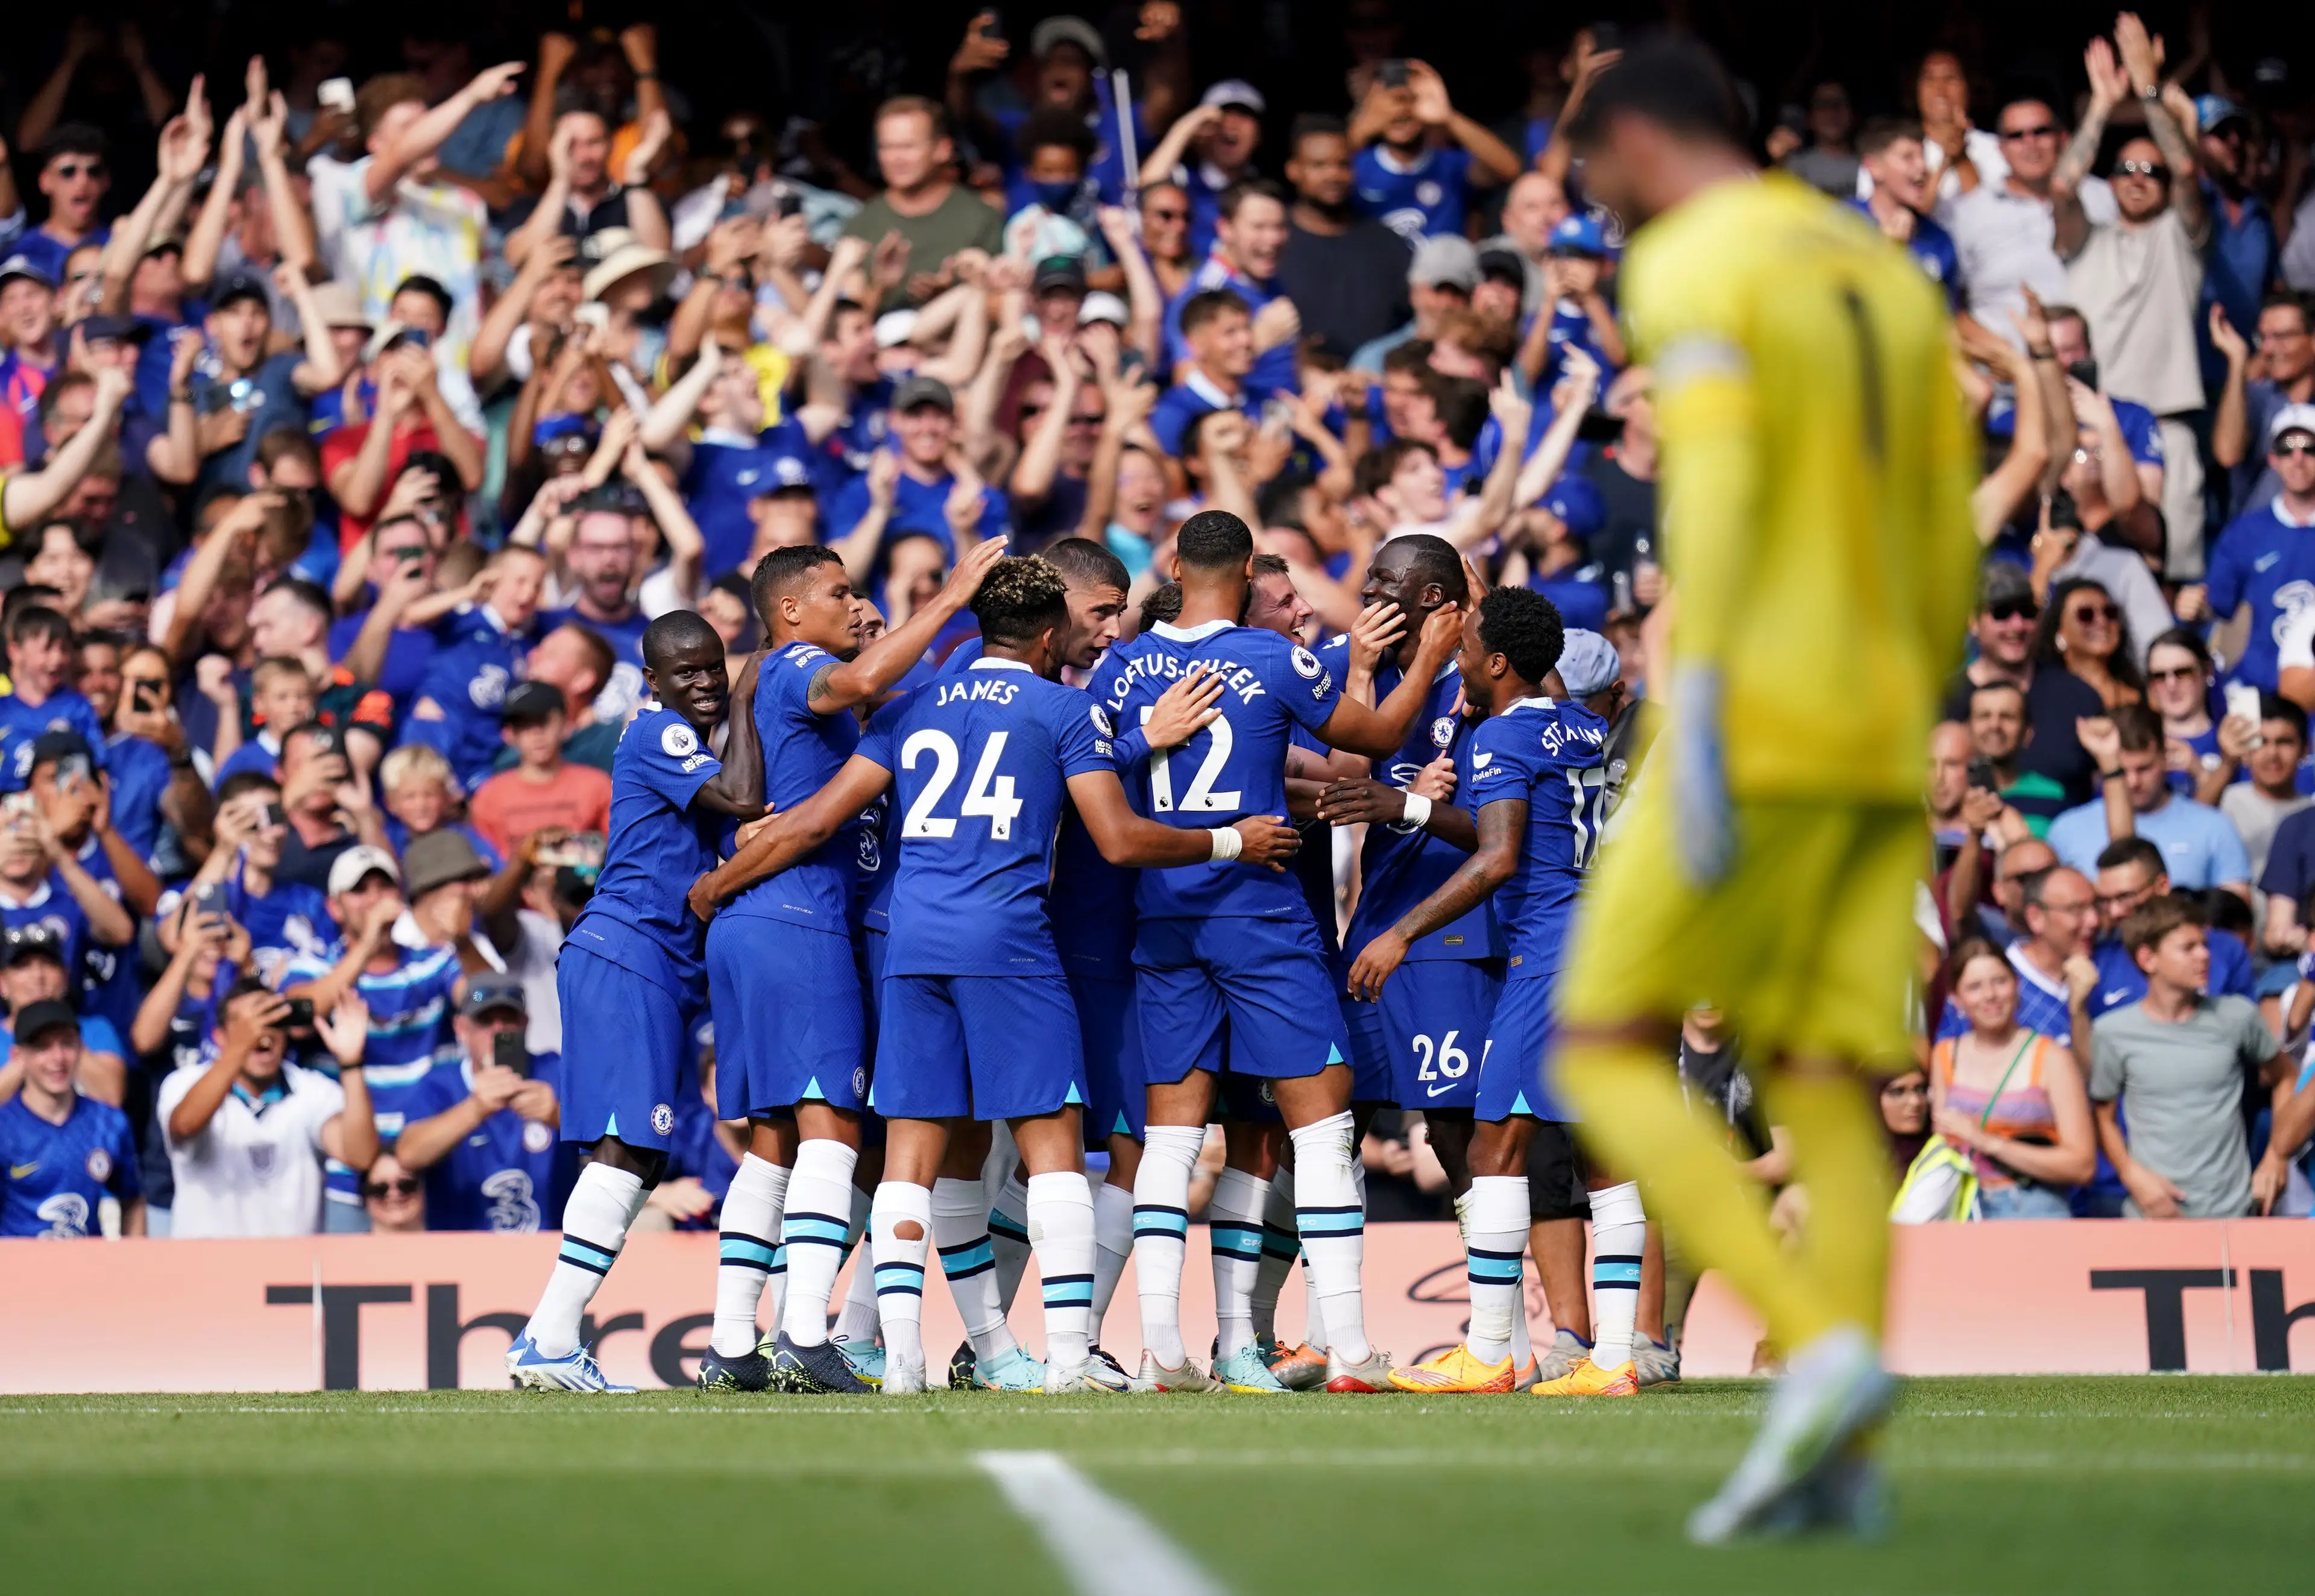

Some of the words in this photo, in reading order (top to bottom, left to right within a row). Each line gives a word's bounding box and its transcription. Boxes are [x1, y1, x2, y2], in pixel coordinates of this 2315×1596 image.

[937, 680, 1019, 706] JAMES
[1107, 653, 1266, 711] LOFTUS-CHEEK
[901, 729, 1024, 841] 24
[1140, 706, 1242, 812] 12
[1472, 767, 1502, 783] WhaleFin
[1566, 767, 1605, 870] 17
[1412, 1030, 1469, 1081] 26
